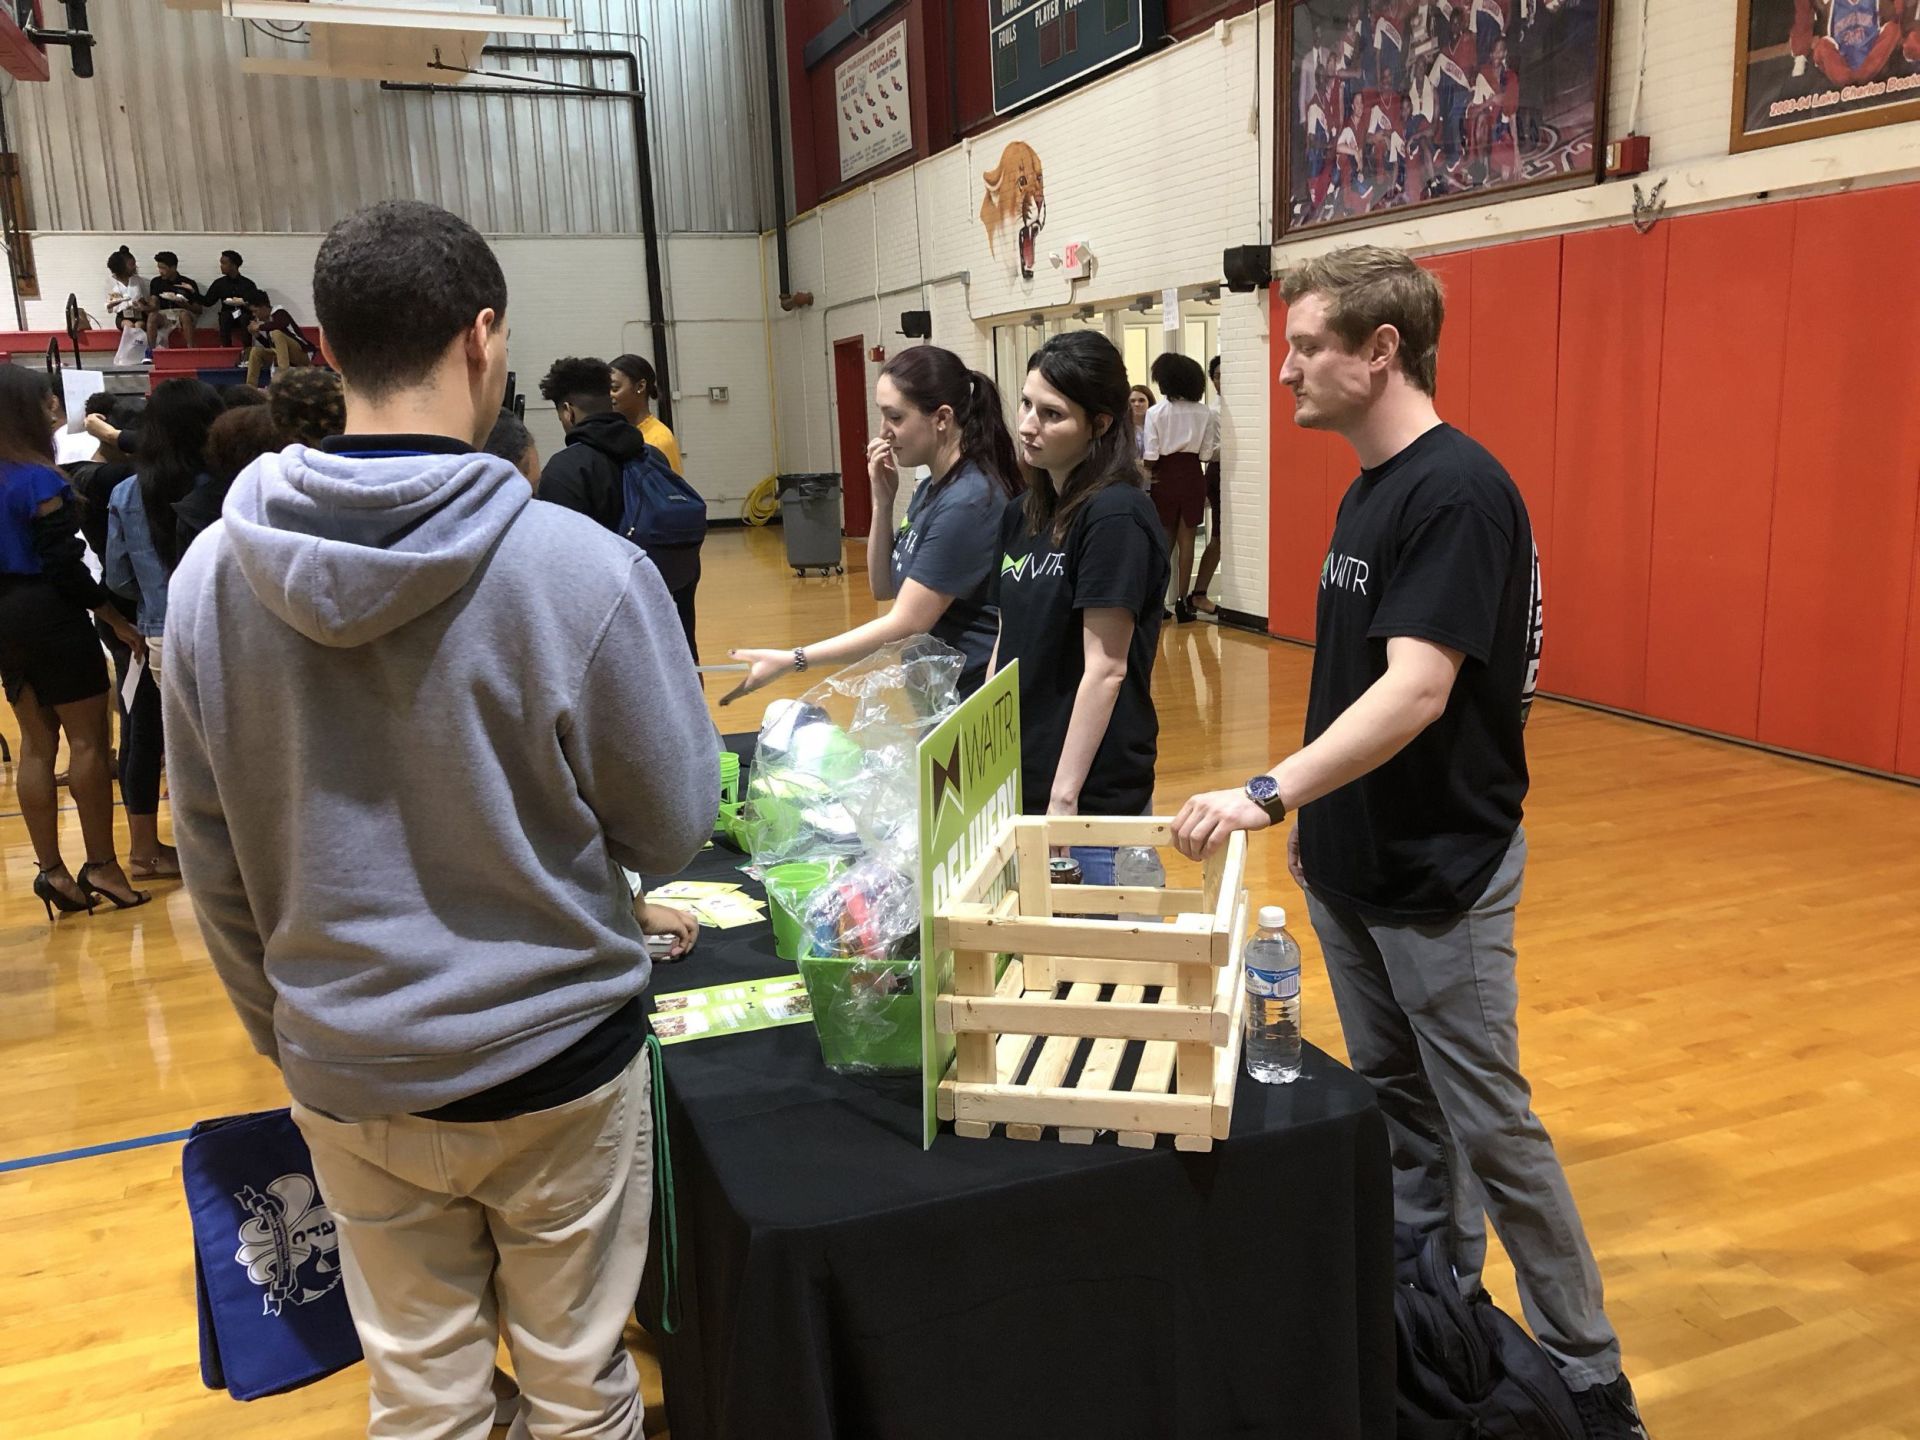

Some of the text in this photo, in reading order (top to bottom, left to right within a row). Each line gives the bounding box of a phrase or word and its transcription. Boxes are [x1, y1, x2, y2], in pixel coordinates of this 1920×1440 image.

[1035, 0, 1060, 28] PLAYER
[998, 24, 1016, 48] FOULS
[869, 46, 897, 73] COUGARS
[1812, 90, 1840, 108] Lake
[1841, 82, 1886, 101] Charles
[964, 691, 1014, 789] WAITR
